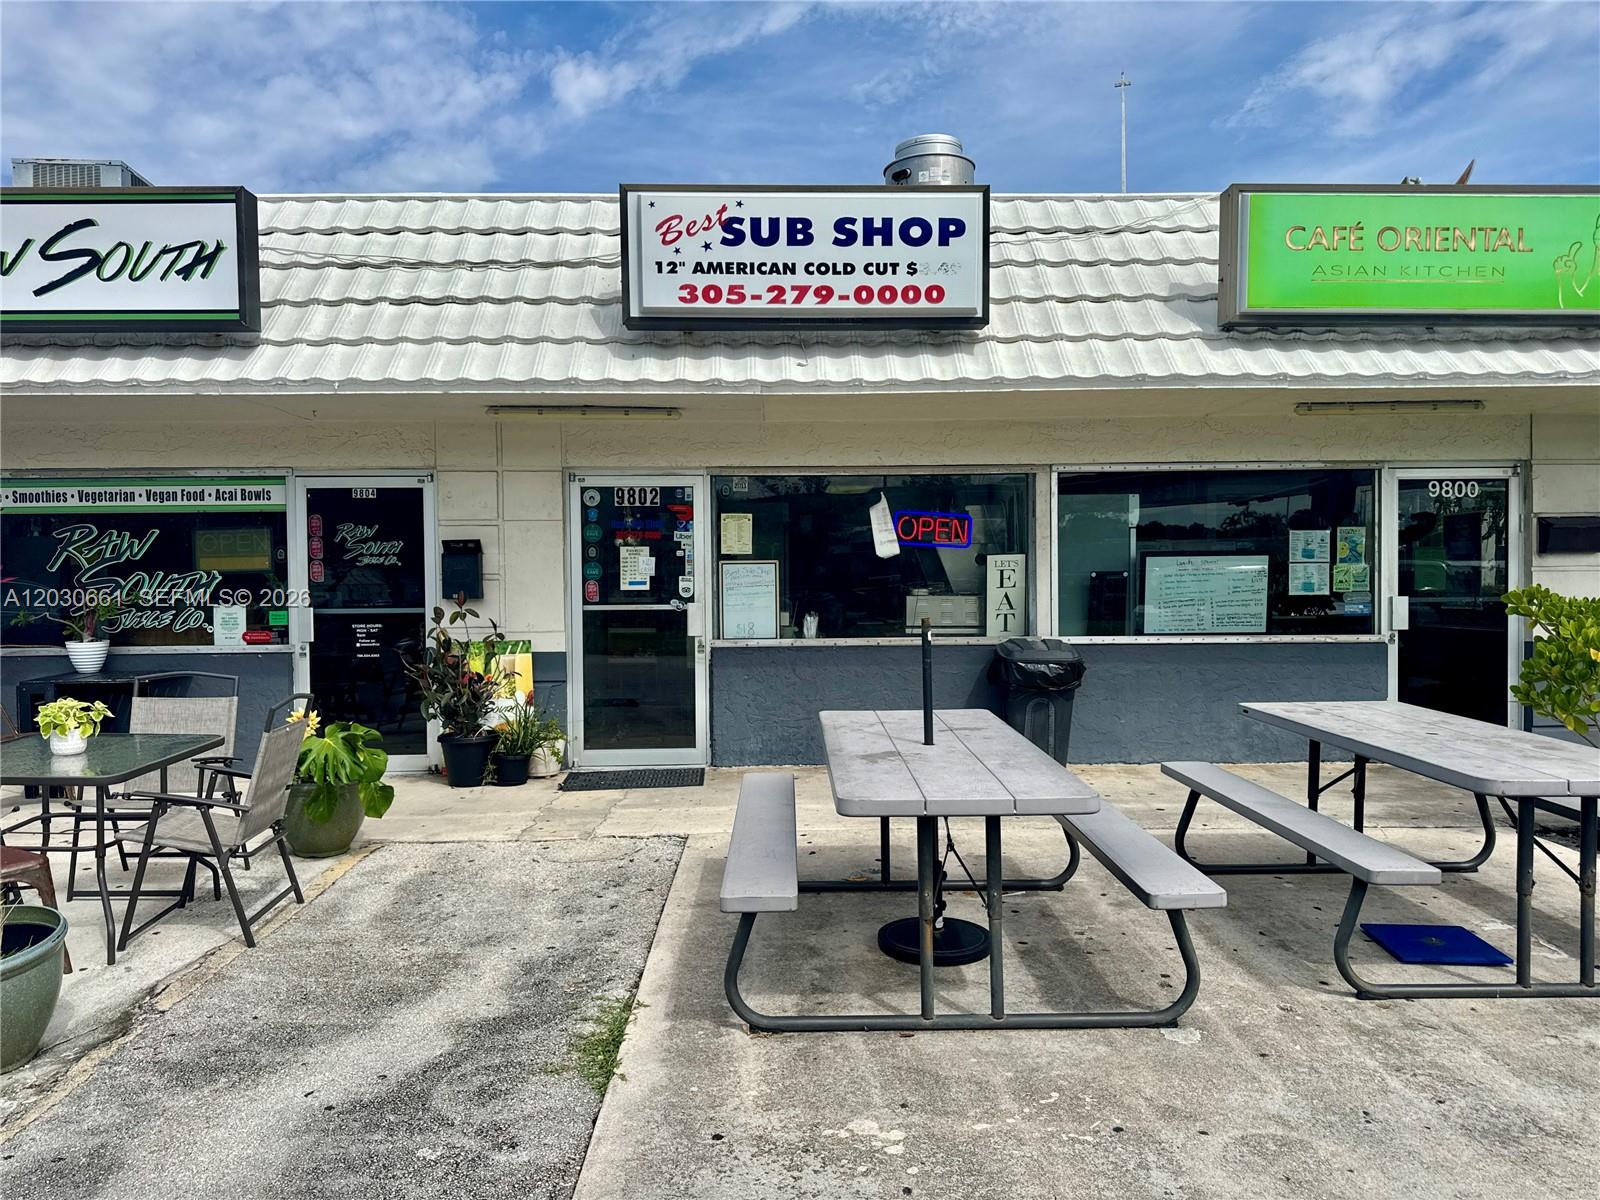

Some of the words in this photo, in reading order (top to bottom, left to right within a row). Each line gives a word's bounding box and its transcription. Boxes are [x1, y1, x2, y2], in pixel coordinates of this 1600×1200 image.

[655, 203, 728, 246] Best
[719, 216, 814, 247] SUB
[832, 216, 966, 247] SHOP
[1285, 221, 1364, 252] CAFÉ
[1377, 226, 1533, 253] ORIENTAL
[33, 218, 228, 297] SOUTH
[654, 261, 686, 275] 12"
[692, 262, 797, 275] AMERICAN
[804, 262, 856, 275] COLD
[863, 262, 900, 275] CUT
[1311, 263, 1387, 277] ASIAN
[1400, 264, 1506, 278] KITCHEN
[678, 283, 946, 305] 305-279-0000
[12, 490, 68, 503] Smoothies
[77, 489, 136, 504] Vegetarian
[145, 488, 178, 503] Vegan
[180, 488, 205, 502] Food
[215, 488, 238, 502] Acai
[240, 488, 272, 501] Bowls
[353, 489, 376, 498] 9804
[615, 487, 660, 506] 9802
[1428, 480, 1480, 498] 9800
[334, 522, 379, 542] RAW
[675, 532, 693, 540] Uber
[897, 516, 969, 544] OPEN
[46, 523, 160, 572] RAW
[343, 537, 404, 560] SOUTH
[994, 560, 1019, 568] LET'S
[70, 558, 222, 617] SOUTH
[995, 568, 1017, 633] EAT
[101, 608, 176, 634] JUICE
